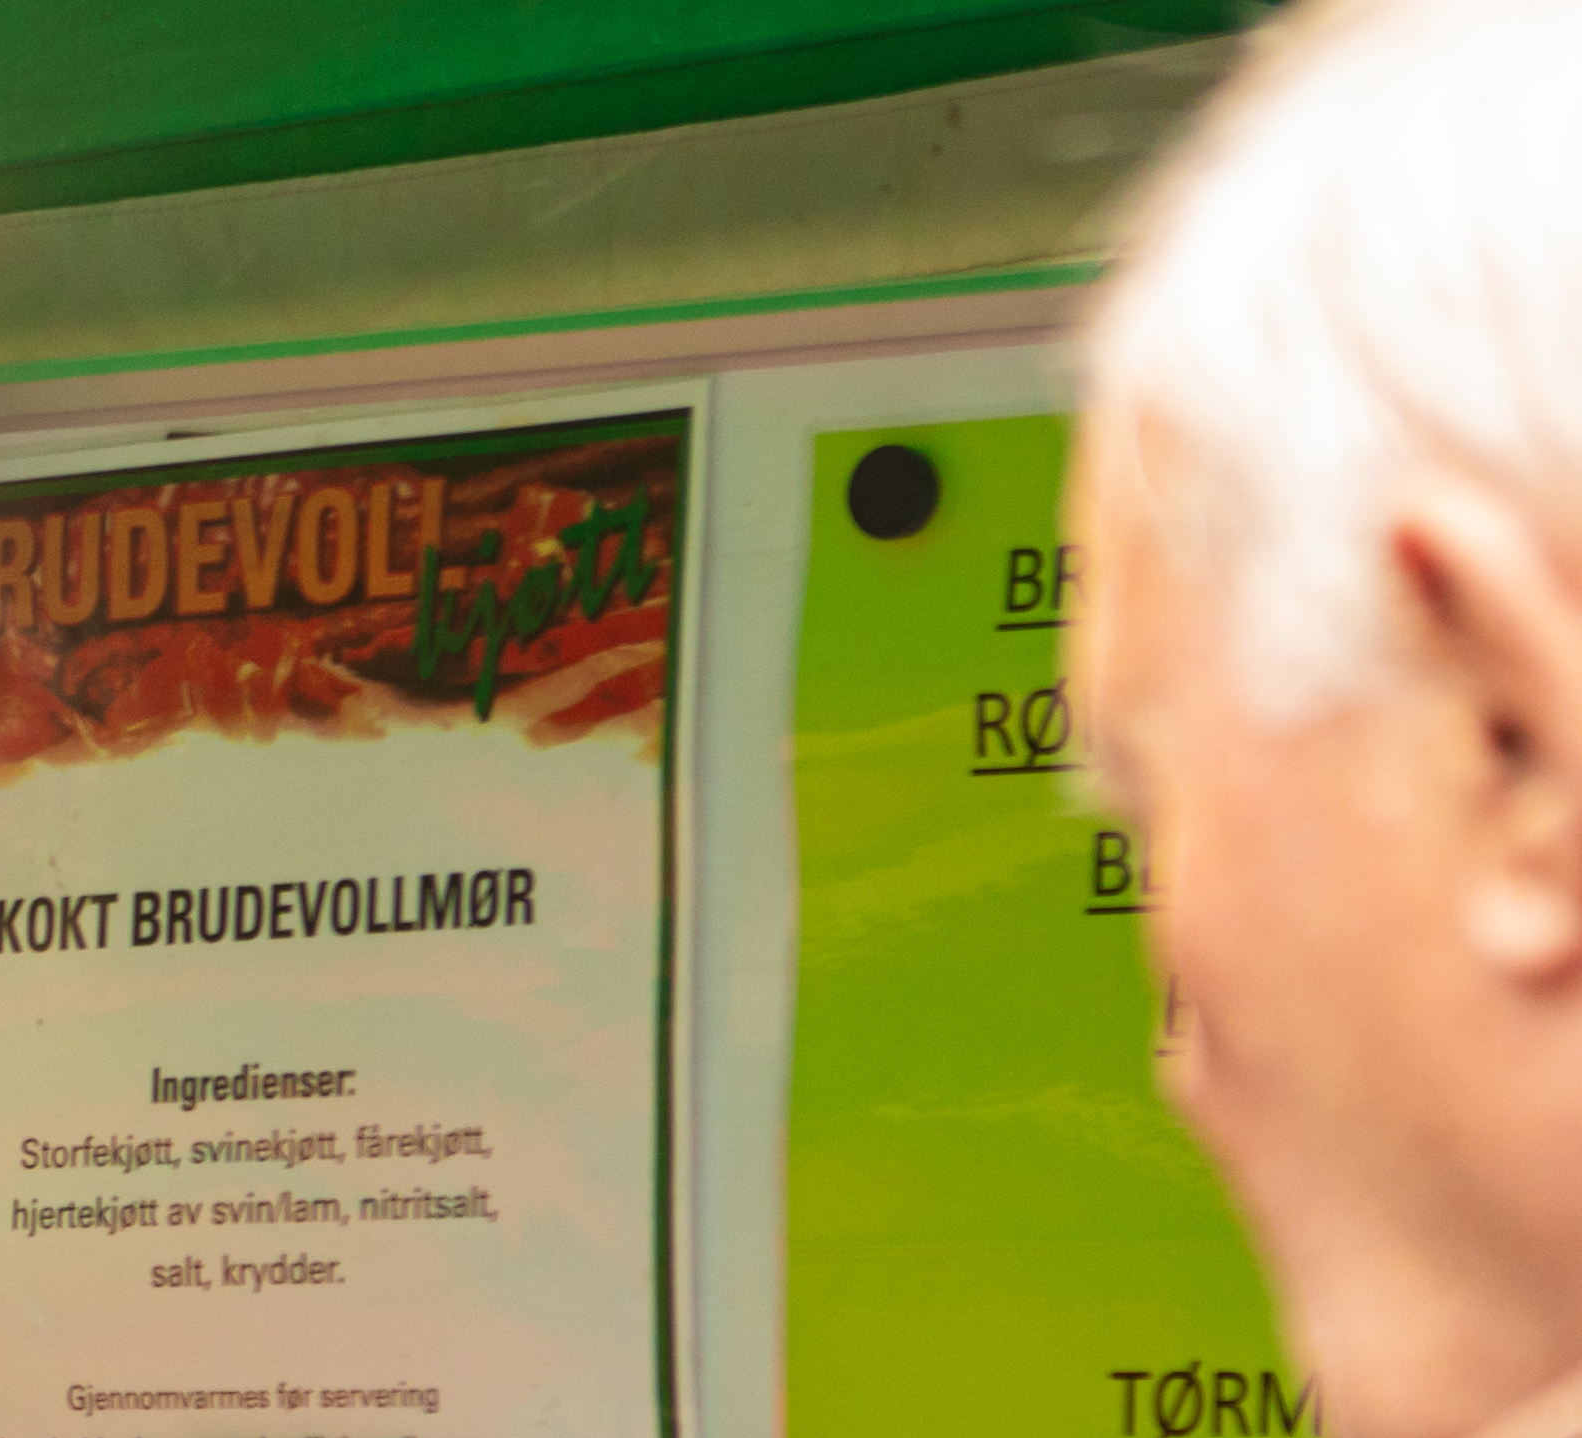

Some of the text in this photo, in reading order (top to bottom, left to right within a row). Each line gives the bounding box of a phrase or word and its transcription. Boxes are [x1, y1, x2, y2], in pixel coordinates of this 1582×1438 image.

[130, 866, 536, 947] BRUDEVOLLMØR
[151, 1063, 356, 1111] Ingredienser:
[20, 1123, 492, 1174] Storfekjøtt, svinekjøtt, fårekjøtt,
[11, 1187, 499, 1236] hjertekjøtt av svin/lam, nitritsalt,
[150, 1252, 346, 1293] salt, krydder.
[66, 1381, 440, 1415] Gjennomvarmes før servering
